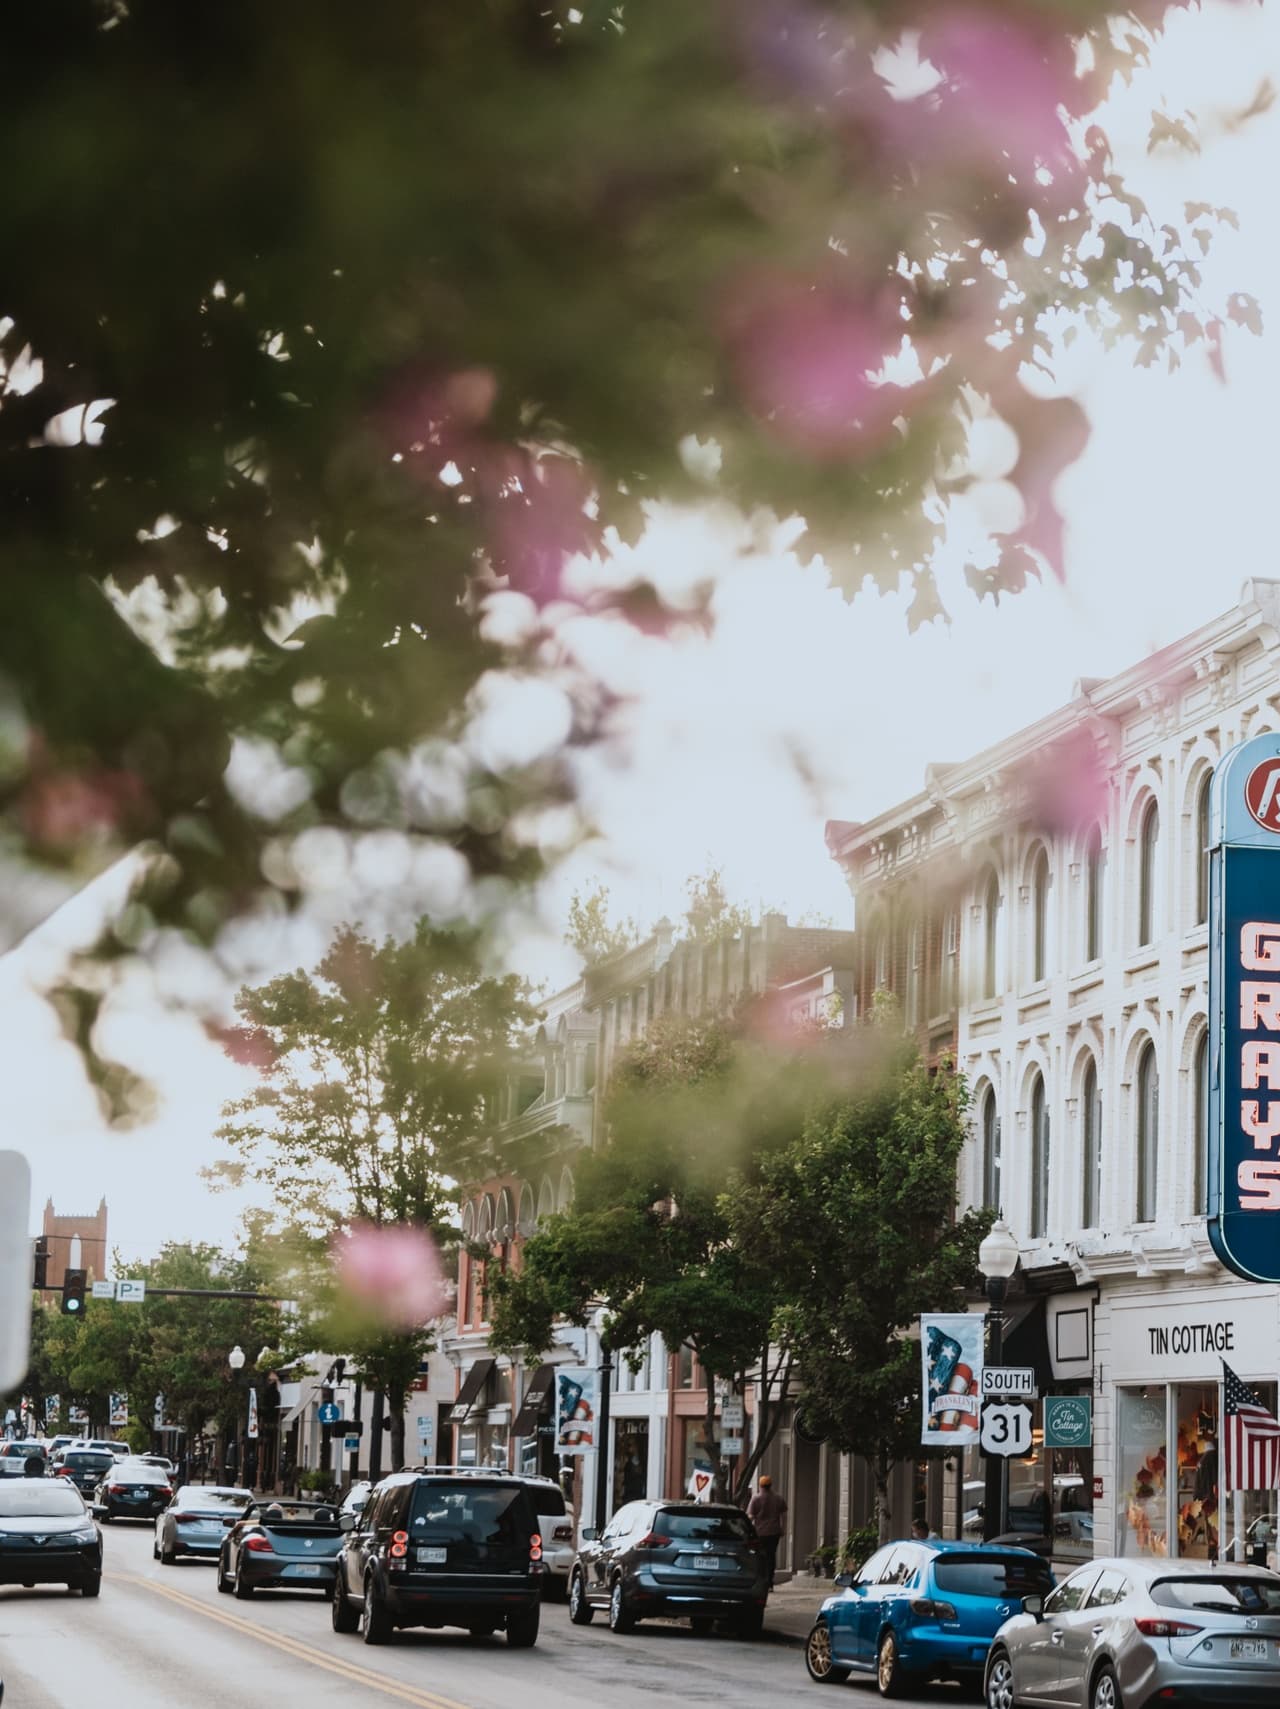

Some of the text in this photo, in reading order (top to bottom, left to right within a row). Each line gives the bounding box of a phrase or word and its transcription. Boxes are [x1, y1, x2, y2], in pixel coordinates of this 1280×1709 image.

[1148, 1322, 1235, 1355] TIN COTTAGE
[984, 1372, 1031, 1389] SOUTH
[1060, 1410, 1075, 1422] Tin
[991, 1413, 1021, 1443] 31
[1052, 1418, 1084, 1433] Cottage
